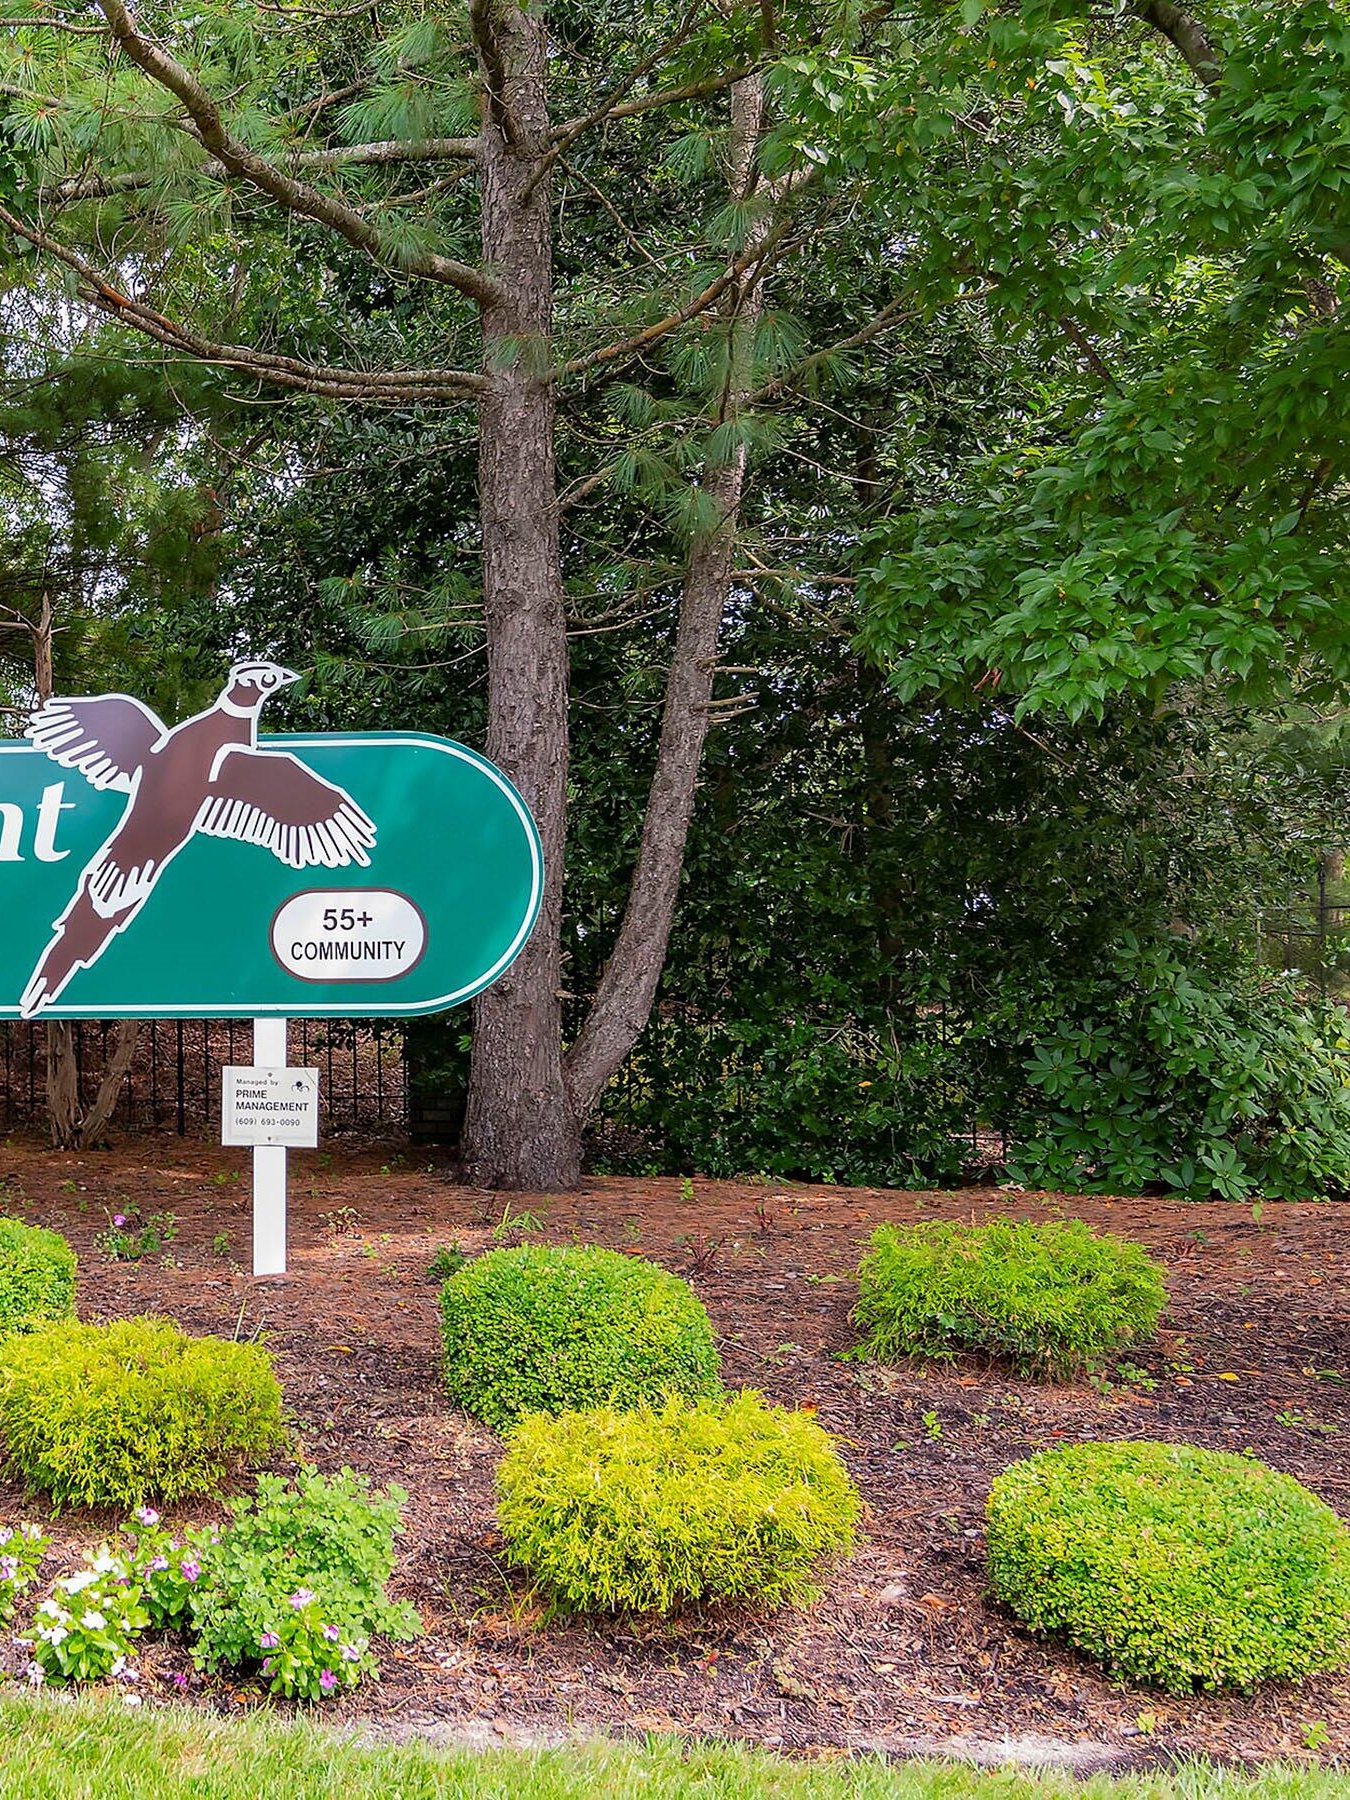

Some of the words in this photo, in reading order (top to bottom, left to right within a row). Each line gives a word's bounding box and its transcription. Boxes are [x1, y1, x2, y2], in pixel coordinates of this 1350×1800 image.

[322, 908, 373, 931] 55+
[291, 941, 406, 960] COMMUNITY
[236, 1089, 267, 1099] PRIME
[235, 1101, 309, 1111] MANAGEMENT
[235, 1117, 257, 1125] (609)
